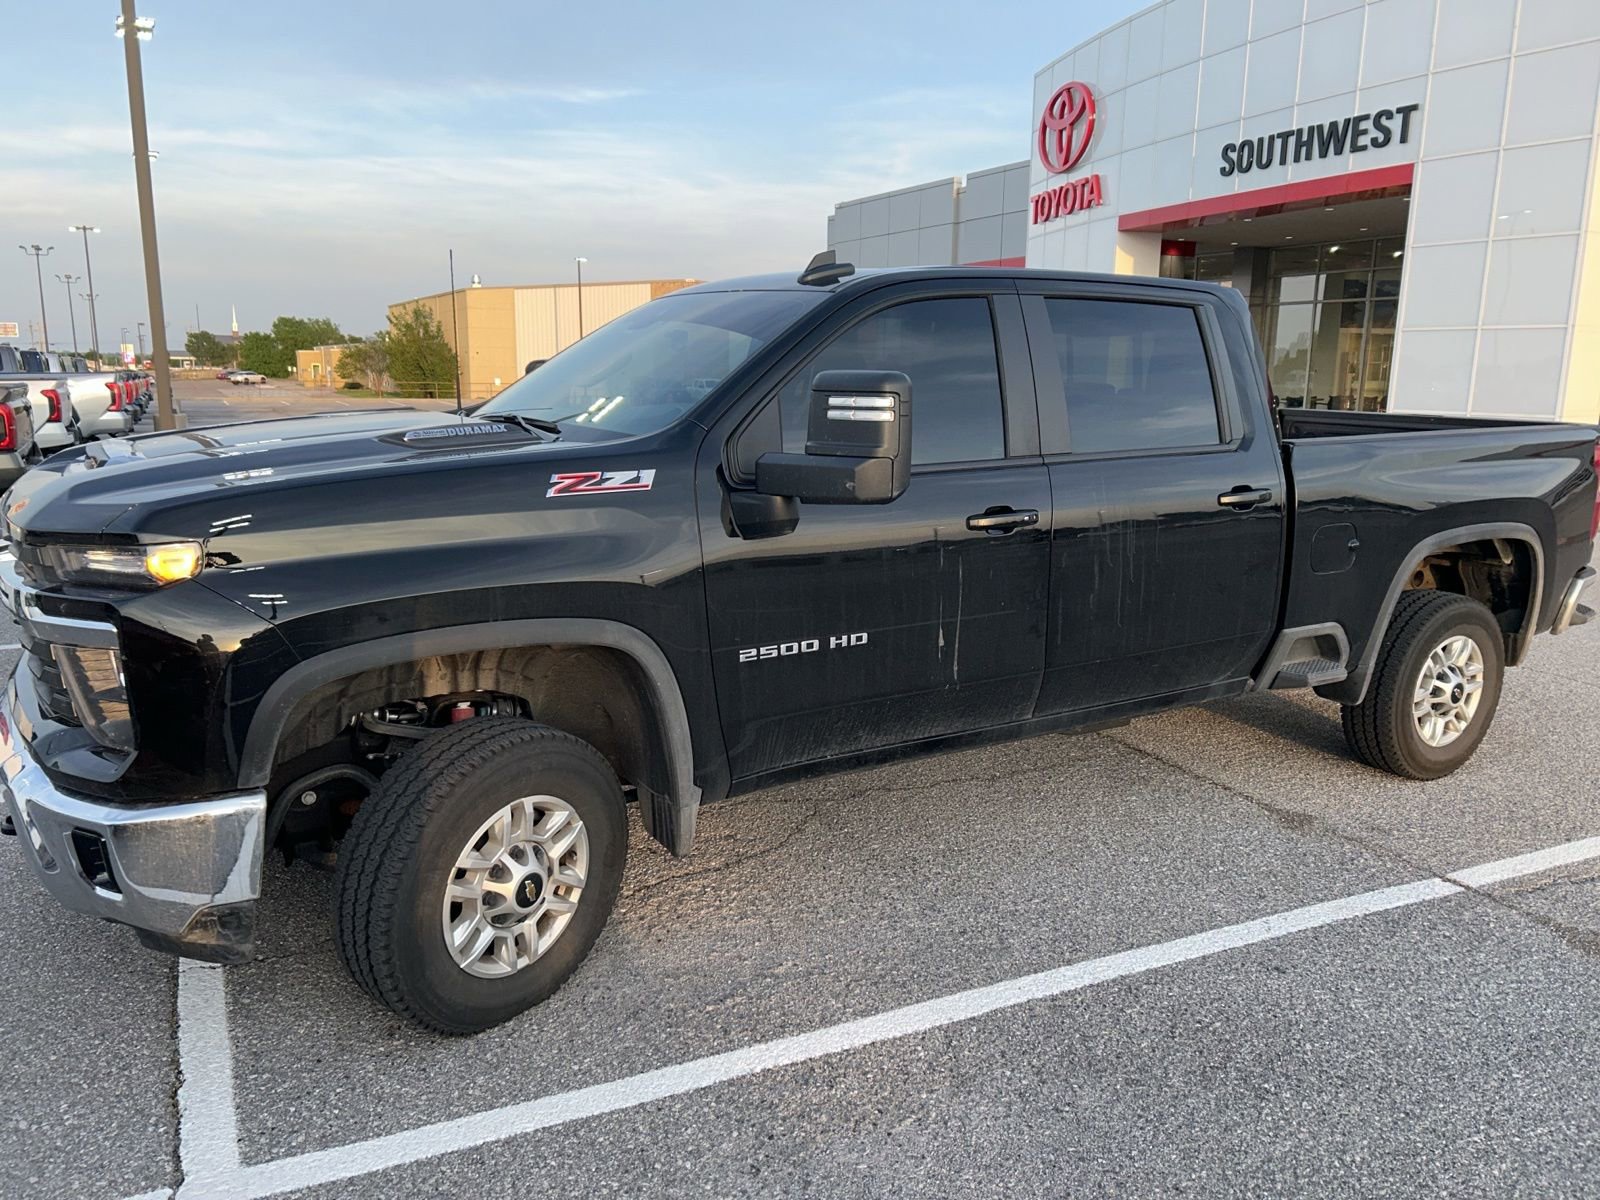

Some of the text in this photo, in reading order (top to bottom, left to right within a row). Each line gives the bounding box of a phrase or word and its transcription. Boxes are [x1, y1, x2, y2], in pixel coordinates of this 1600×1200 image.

[1219, 103, 1419, 177] SOUTHWEST
[1030, 174, 1103, 225] TOYOTA
[447, 424, 507, 436] DURAMAX
[546, 469, 656, 498] Z71
[739, 632, 868, 663] 2500 HD
